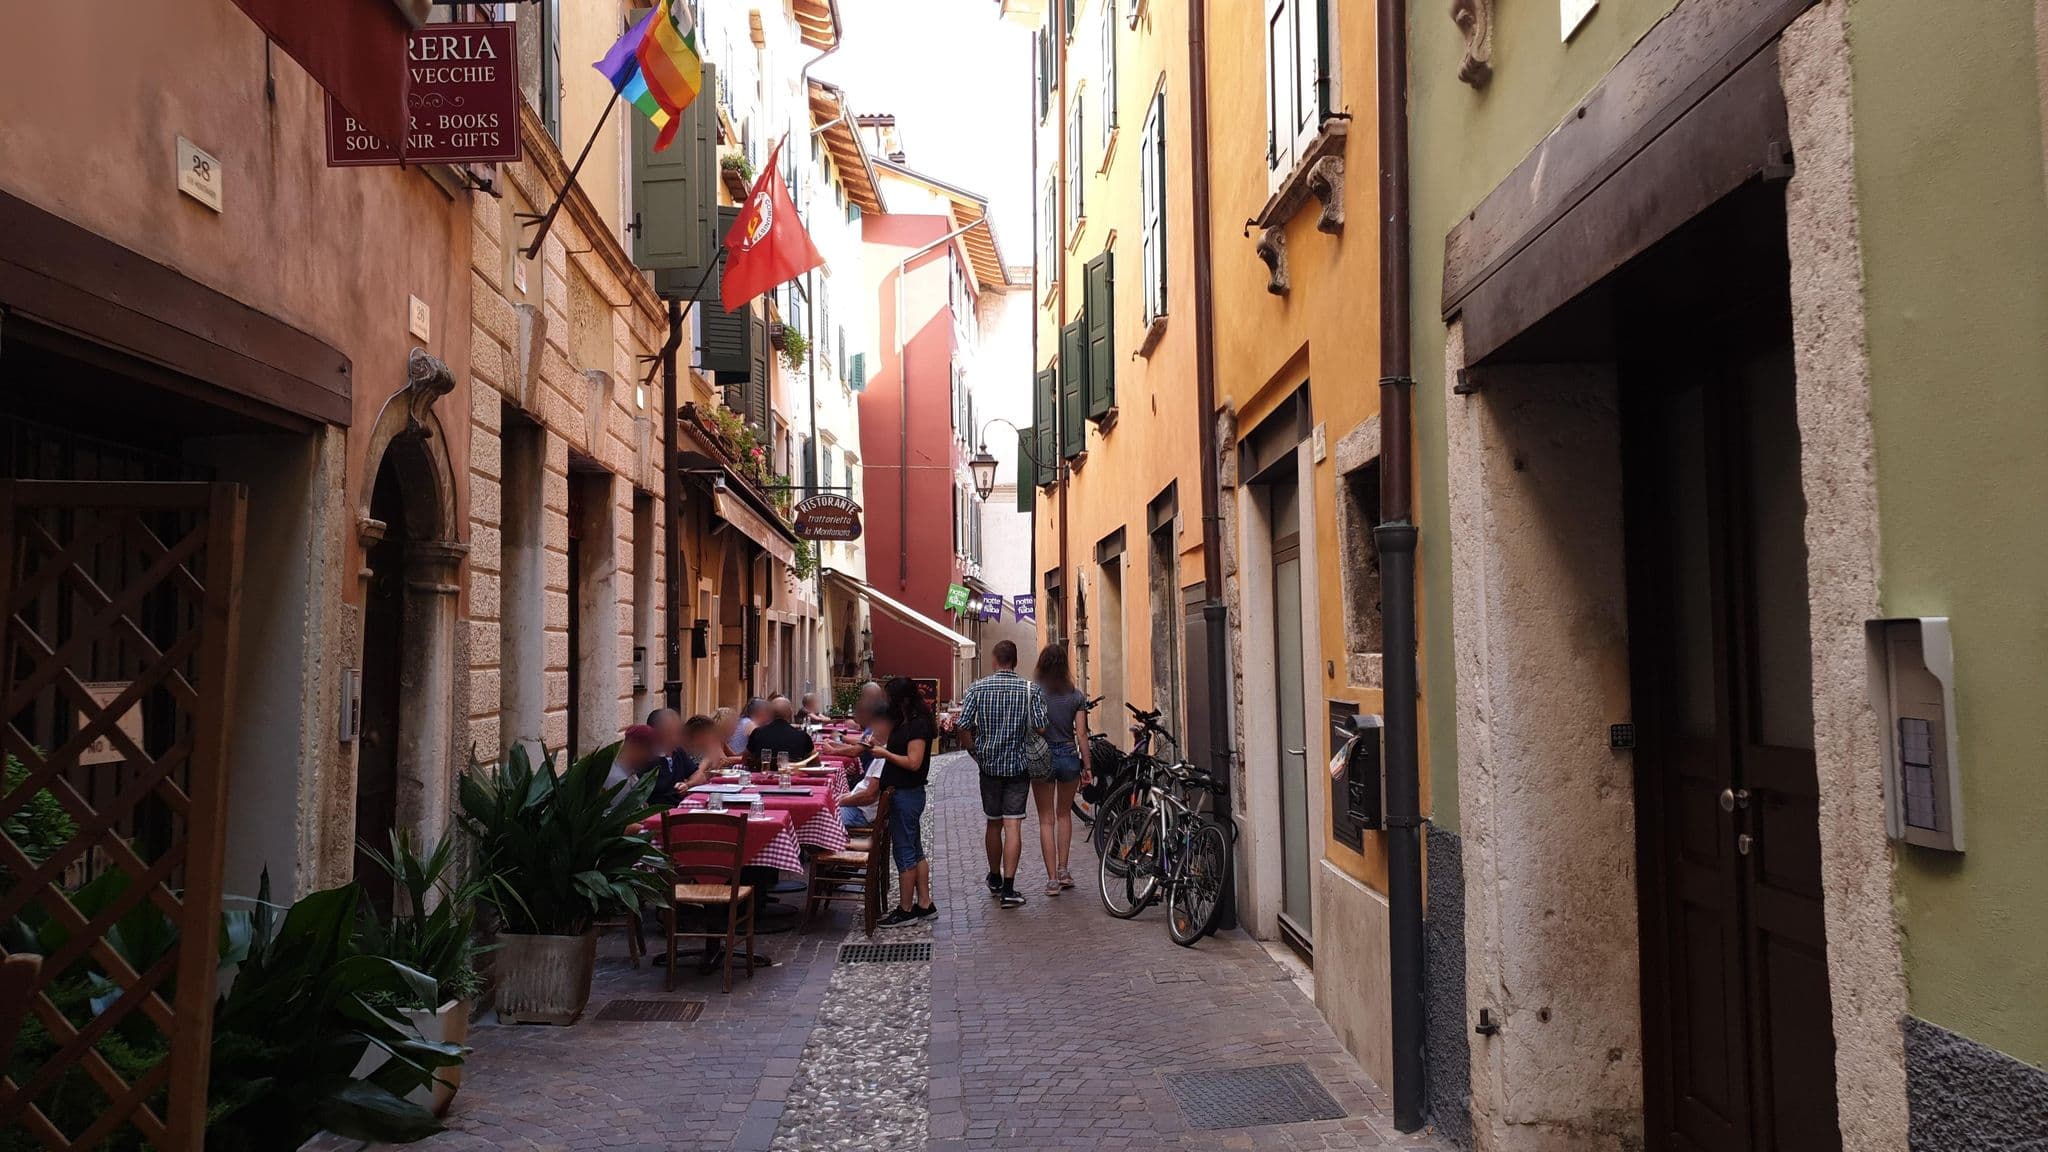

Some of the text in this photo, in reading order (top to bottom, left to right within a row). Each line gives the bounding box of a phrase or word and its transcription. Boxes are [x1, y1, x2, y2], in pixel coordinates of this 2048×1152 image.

[411, 66, 496, 84] VECCHIE
[439, 113, 499, 129] BOOKS
[346, 132, 435, 151] SOUNIR
[451, 131, 500, 148] GIFTS
[192, 154, 210, 183] 28
[800, 496, 857, 516] RISTORANTE
